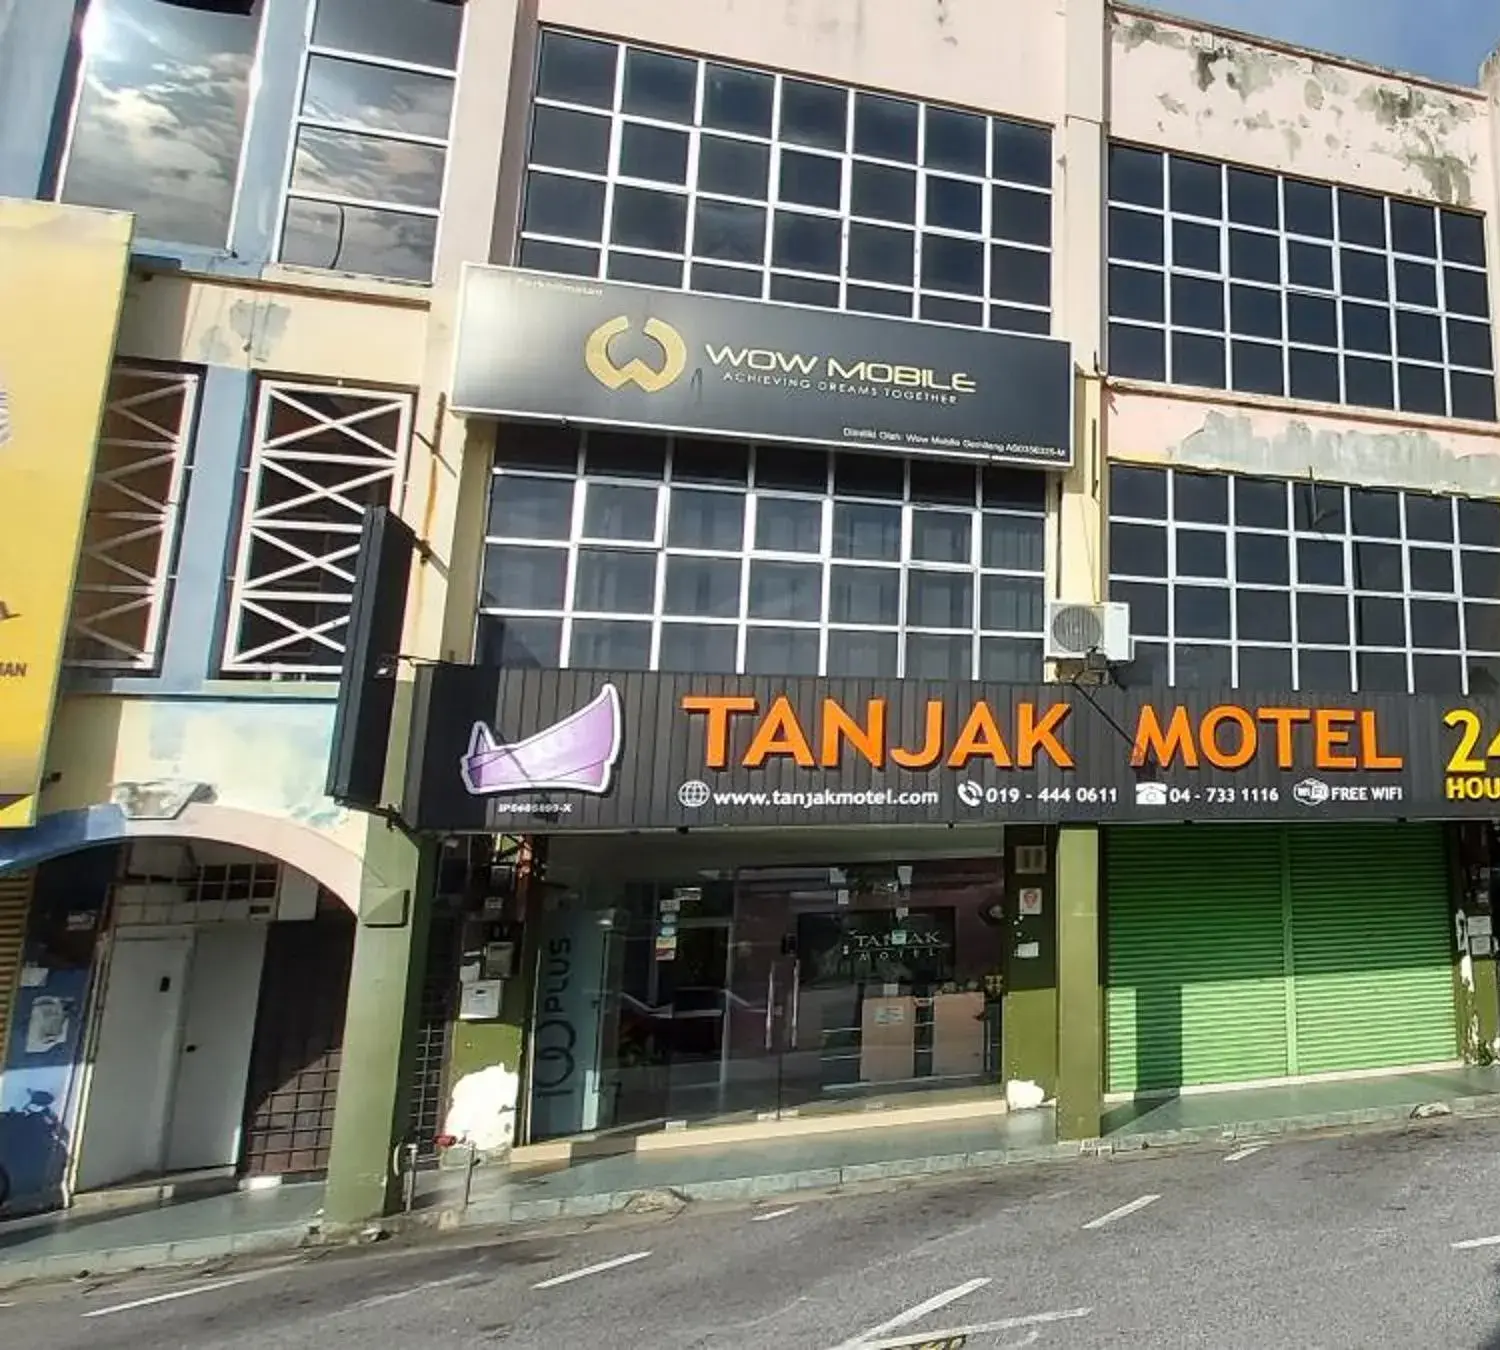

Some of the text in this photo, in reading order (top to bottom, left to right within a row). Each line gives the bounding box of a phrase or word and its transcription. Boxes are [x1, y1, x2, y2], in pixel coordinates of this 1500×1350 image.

[704, 343, 976, 393] WOW MOBILE
[723, 371, 958, 405] ACHIEVING DREAMS TOGETHER
[681, 696, 1403, 770] TANJAK MOTEL
[713, 788, 939, 809] www.tanjakmotel.com
[985, 787, 1020, 803] 019
[1037, 787, 1072, 803] 444
[1076, 787, 1118, 803] 0611
[1168, 788, 1191, 804] 04
[1206, 787, 1236, 803] 733
[1241, 787, 1279, 802] 1116
[1331, 786, 1403, 801] FREE WIFI
[853, 929, 940, 947] TANAK
